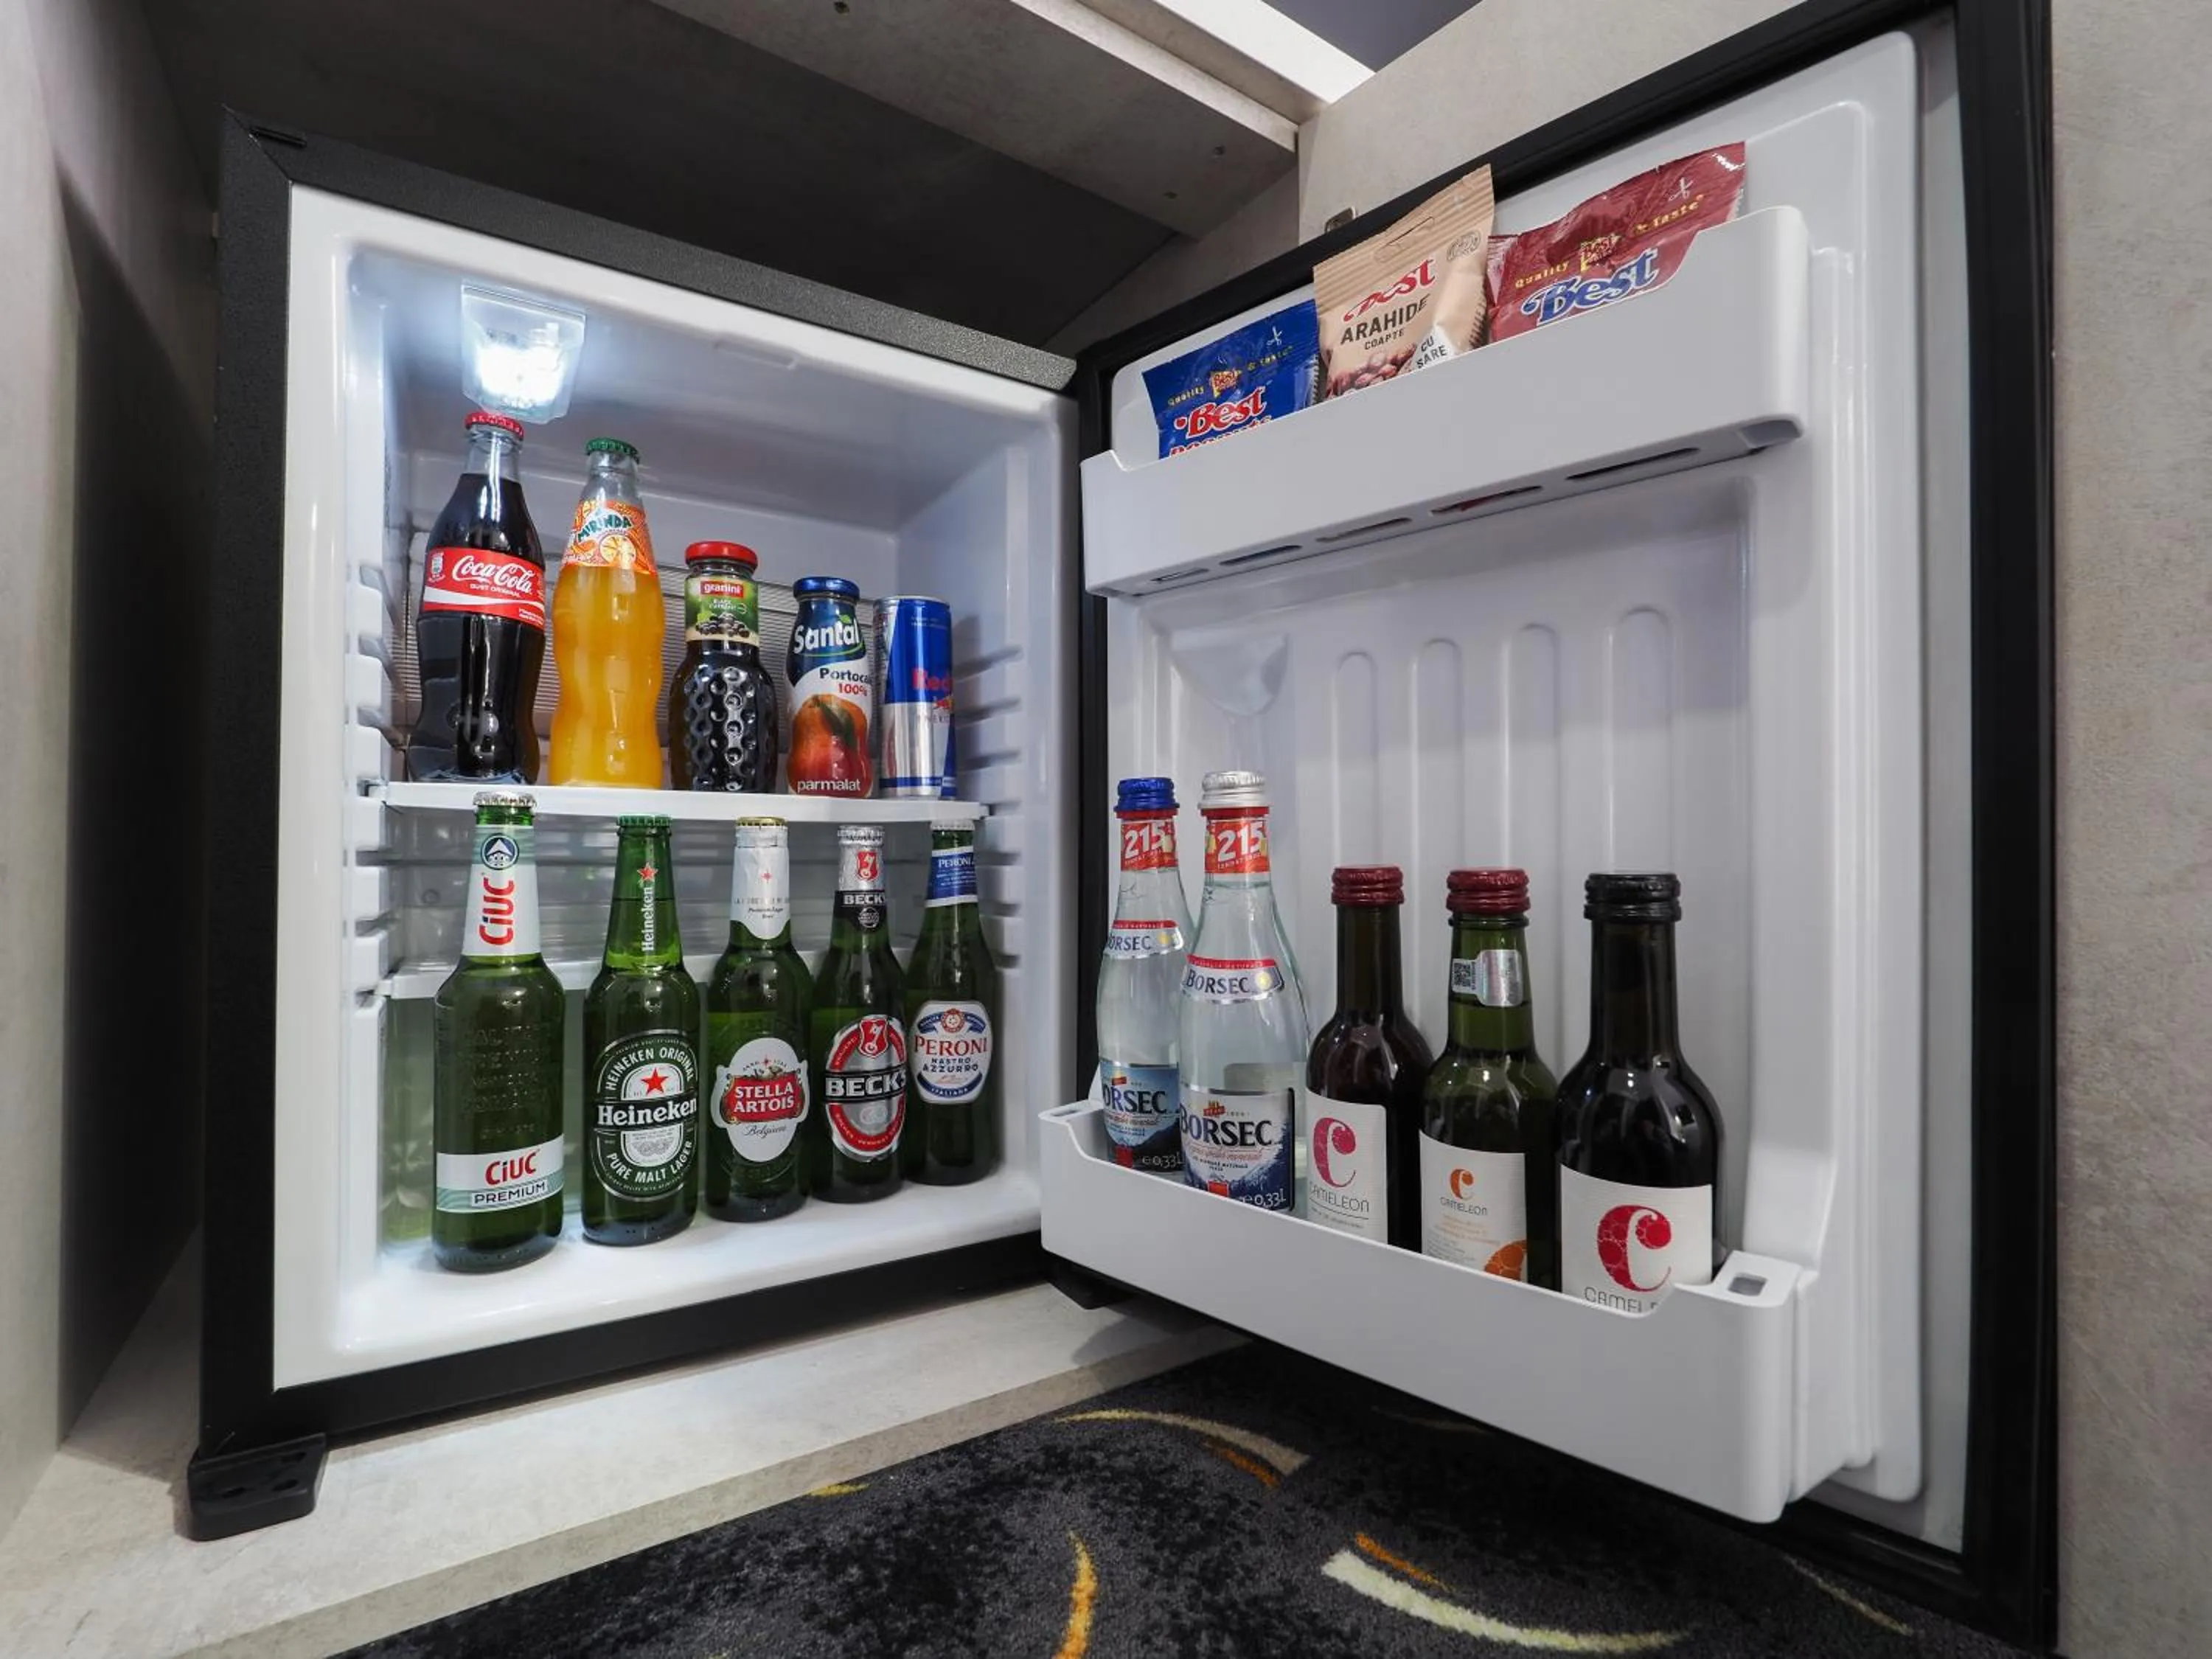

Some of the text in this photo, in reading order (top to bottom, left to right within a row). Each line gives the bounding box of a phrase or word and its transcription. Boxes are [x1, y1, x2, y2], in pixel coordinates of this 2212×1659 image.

[1521, 247, 1660, 326] Best
[1340, 293, 1431, 345] ARAHIDE
[1364, 328, 1405, 351] COAPTE
[1421, 336, 1434, 352] CU
[1416, 344, 1448, 369] SARE
[1173, 385, 1267, 440] Best
[452, 554, 536, 594] Coca-Cola
[793, 621, 861, 655] Santal
[797, 778, 861, 796] parmalat
[1124, 821, 1167, 860] 215
[1217, 821, 1264, 863] 215
[844, 894, 886, 905] BECK
[641, 886, 655, 953] Heineken
[1107, 933, 1152, 951] ORSEC
[1186, 968, 1250, 995] BORSEC
[914, 1034, 987, 1057] PERONI
[605, 1047, 654, 1091] HEINEKEN
[658, 1046, 695, 1082] ORIGINAL
[922, 1063, 978, 1073] AZZURRO
[734, 1082, 794, 1099] STELLA
[734, 1095, 794, 1113] ARTOIS
[1102, 1083, 1167, 1114] ORSEC
[597, 1096, 698, 1127] Heineken
[1180, 1102, 1273, 1147] BORSEC
[606, 1152, 632, 1180] PURE
[634, 1167, 667, 1183] MALT
[669, 1140, 692, 1175] LAGER
[473, 1181, 546, 1205] PREMIUM
[1254, 1188, 1287, 1208] 0,33L
